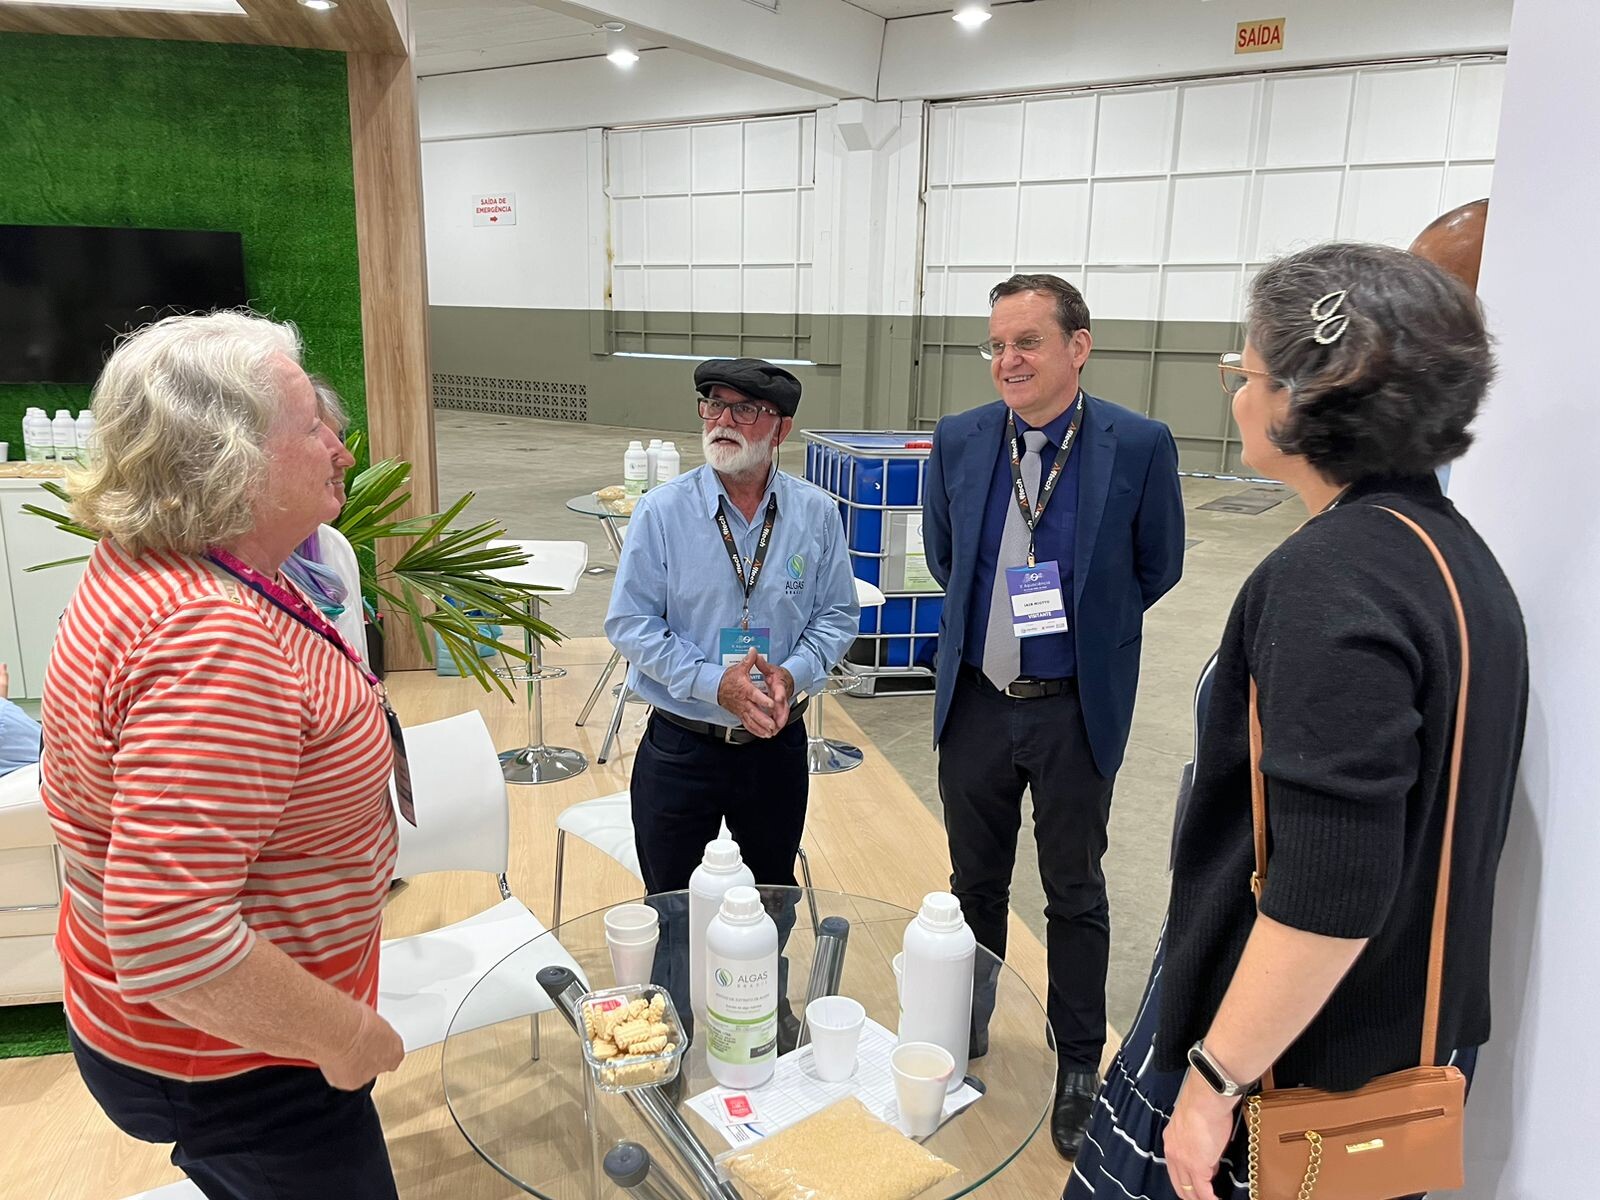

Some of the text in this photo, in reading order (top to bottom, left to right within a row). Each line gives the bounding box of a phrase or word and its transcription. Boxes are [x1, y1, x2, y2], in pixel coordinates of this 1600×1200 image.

[1238, 24, 1281, 48] SAÍDA
[480, 197, 498, 205] SAÍDA
[476, 205, 512, 213] EMERGÊNCIA
[785, 580, 805, 590] ALGAS
[737, 970, 769, 983] ALGAS
